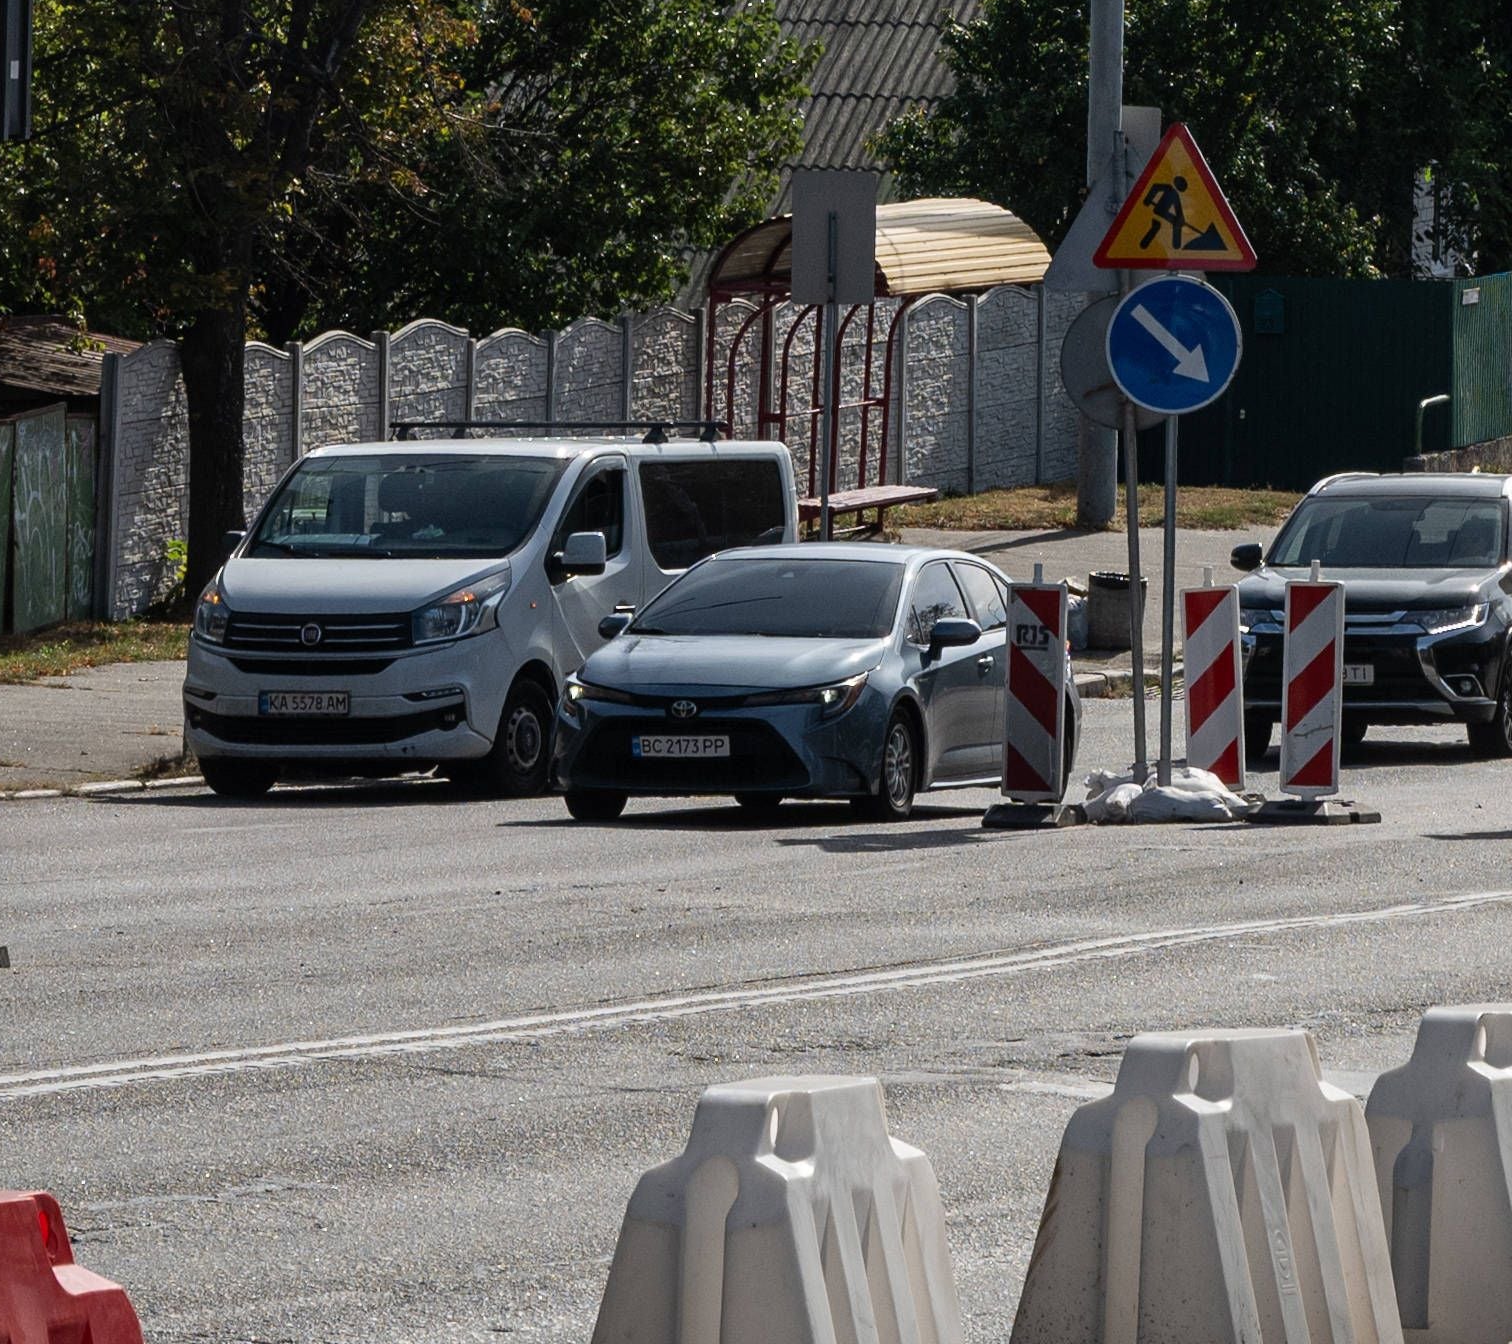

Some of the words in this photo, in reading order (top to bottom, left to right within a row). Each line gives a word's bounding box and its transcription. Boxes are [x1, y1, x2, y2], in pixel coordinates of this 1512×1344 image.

[269, 695, 288, 710] KA
[291, 695, 323, 710] 5578
[326, 695, 346, 710] AM
[642, 739, 663, 753] BC
[666, 739, 700, 754] 2173
[703, 738, 725, 754] PP
